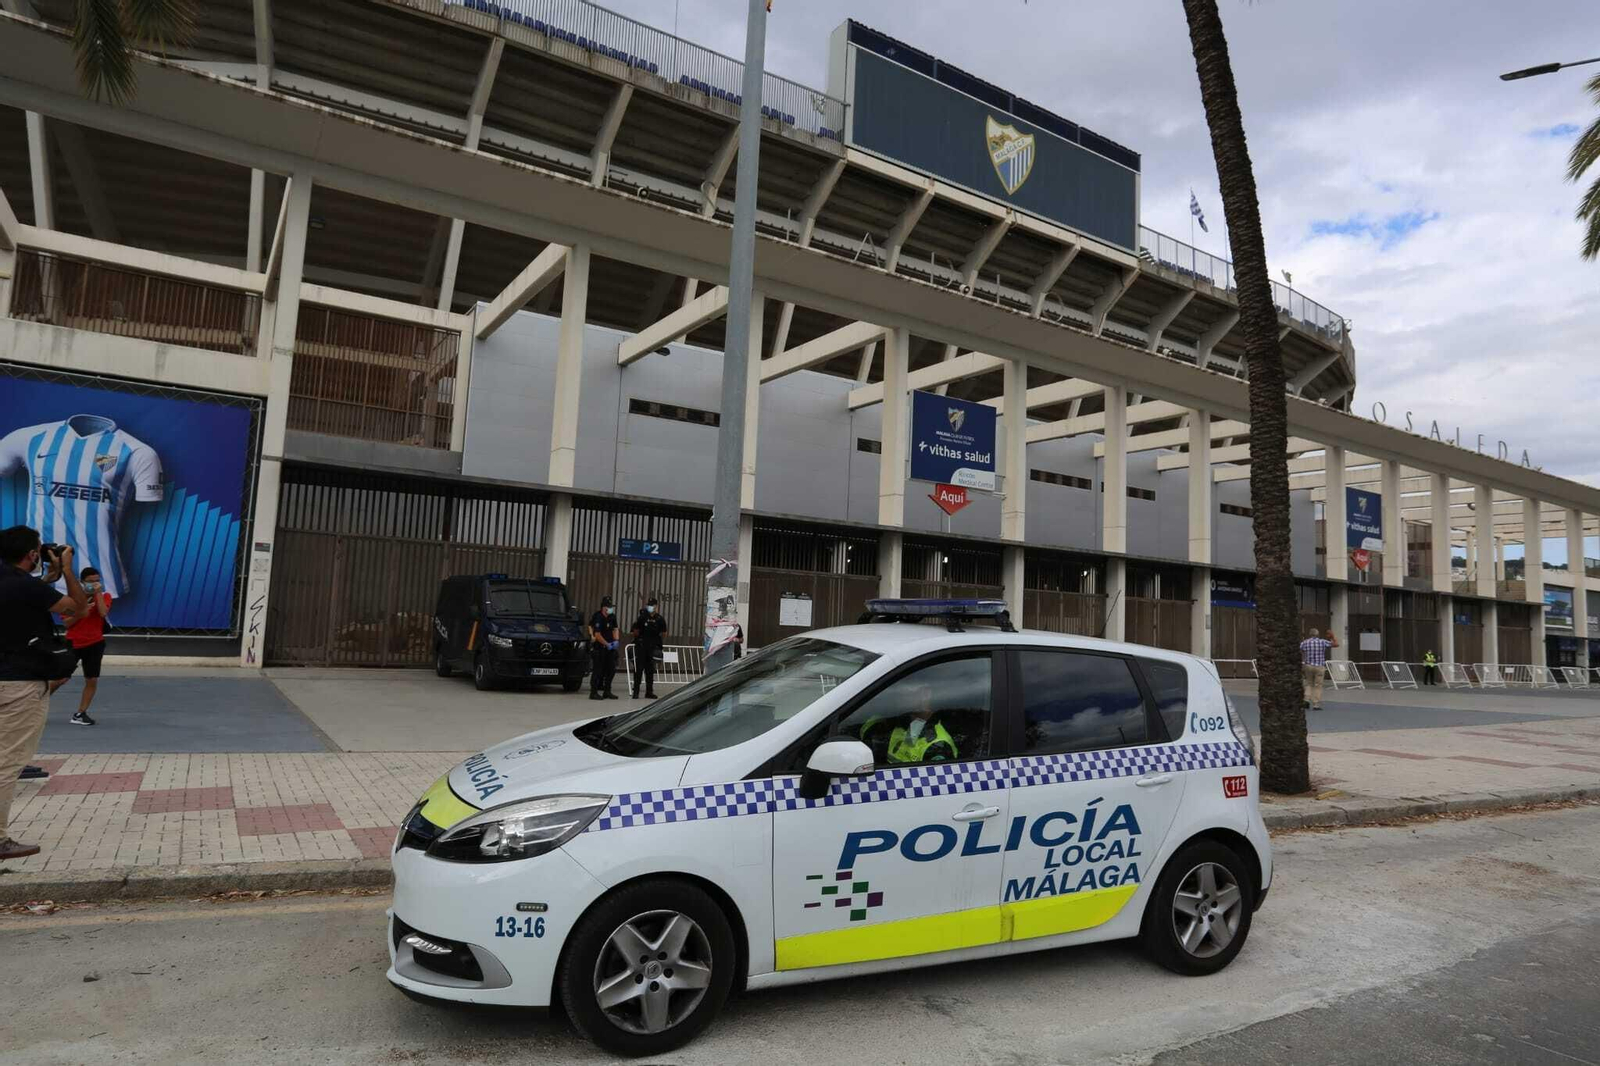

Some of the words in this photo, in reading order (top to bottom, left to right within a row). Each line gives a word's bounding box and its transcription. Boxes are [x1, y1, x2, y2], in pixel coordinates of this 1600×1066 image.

[1349, 401, 1531, 468] OSALEDA
[930, 443, 962, 459] vithas
[964, 450, 991, 464] salud
[940, 490, 964, 504] Aquí
[1199, 716, 1225, 732] 092
[1230, 777, 1247, 792] 112
[836, 796, 1143, 870] POLICÍA
[1043, 837, 1143, 869] LOCAL
[1003, 862, 1141, 902] MÁLAGA
[495, 916, 546, 938] 13-16
